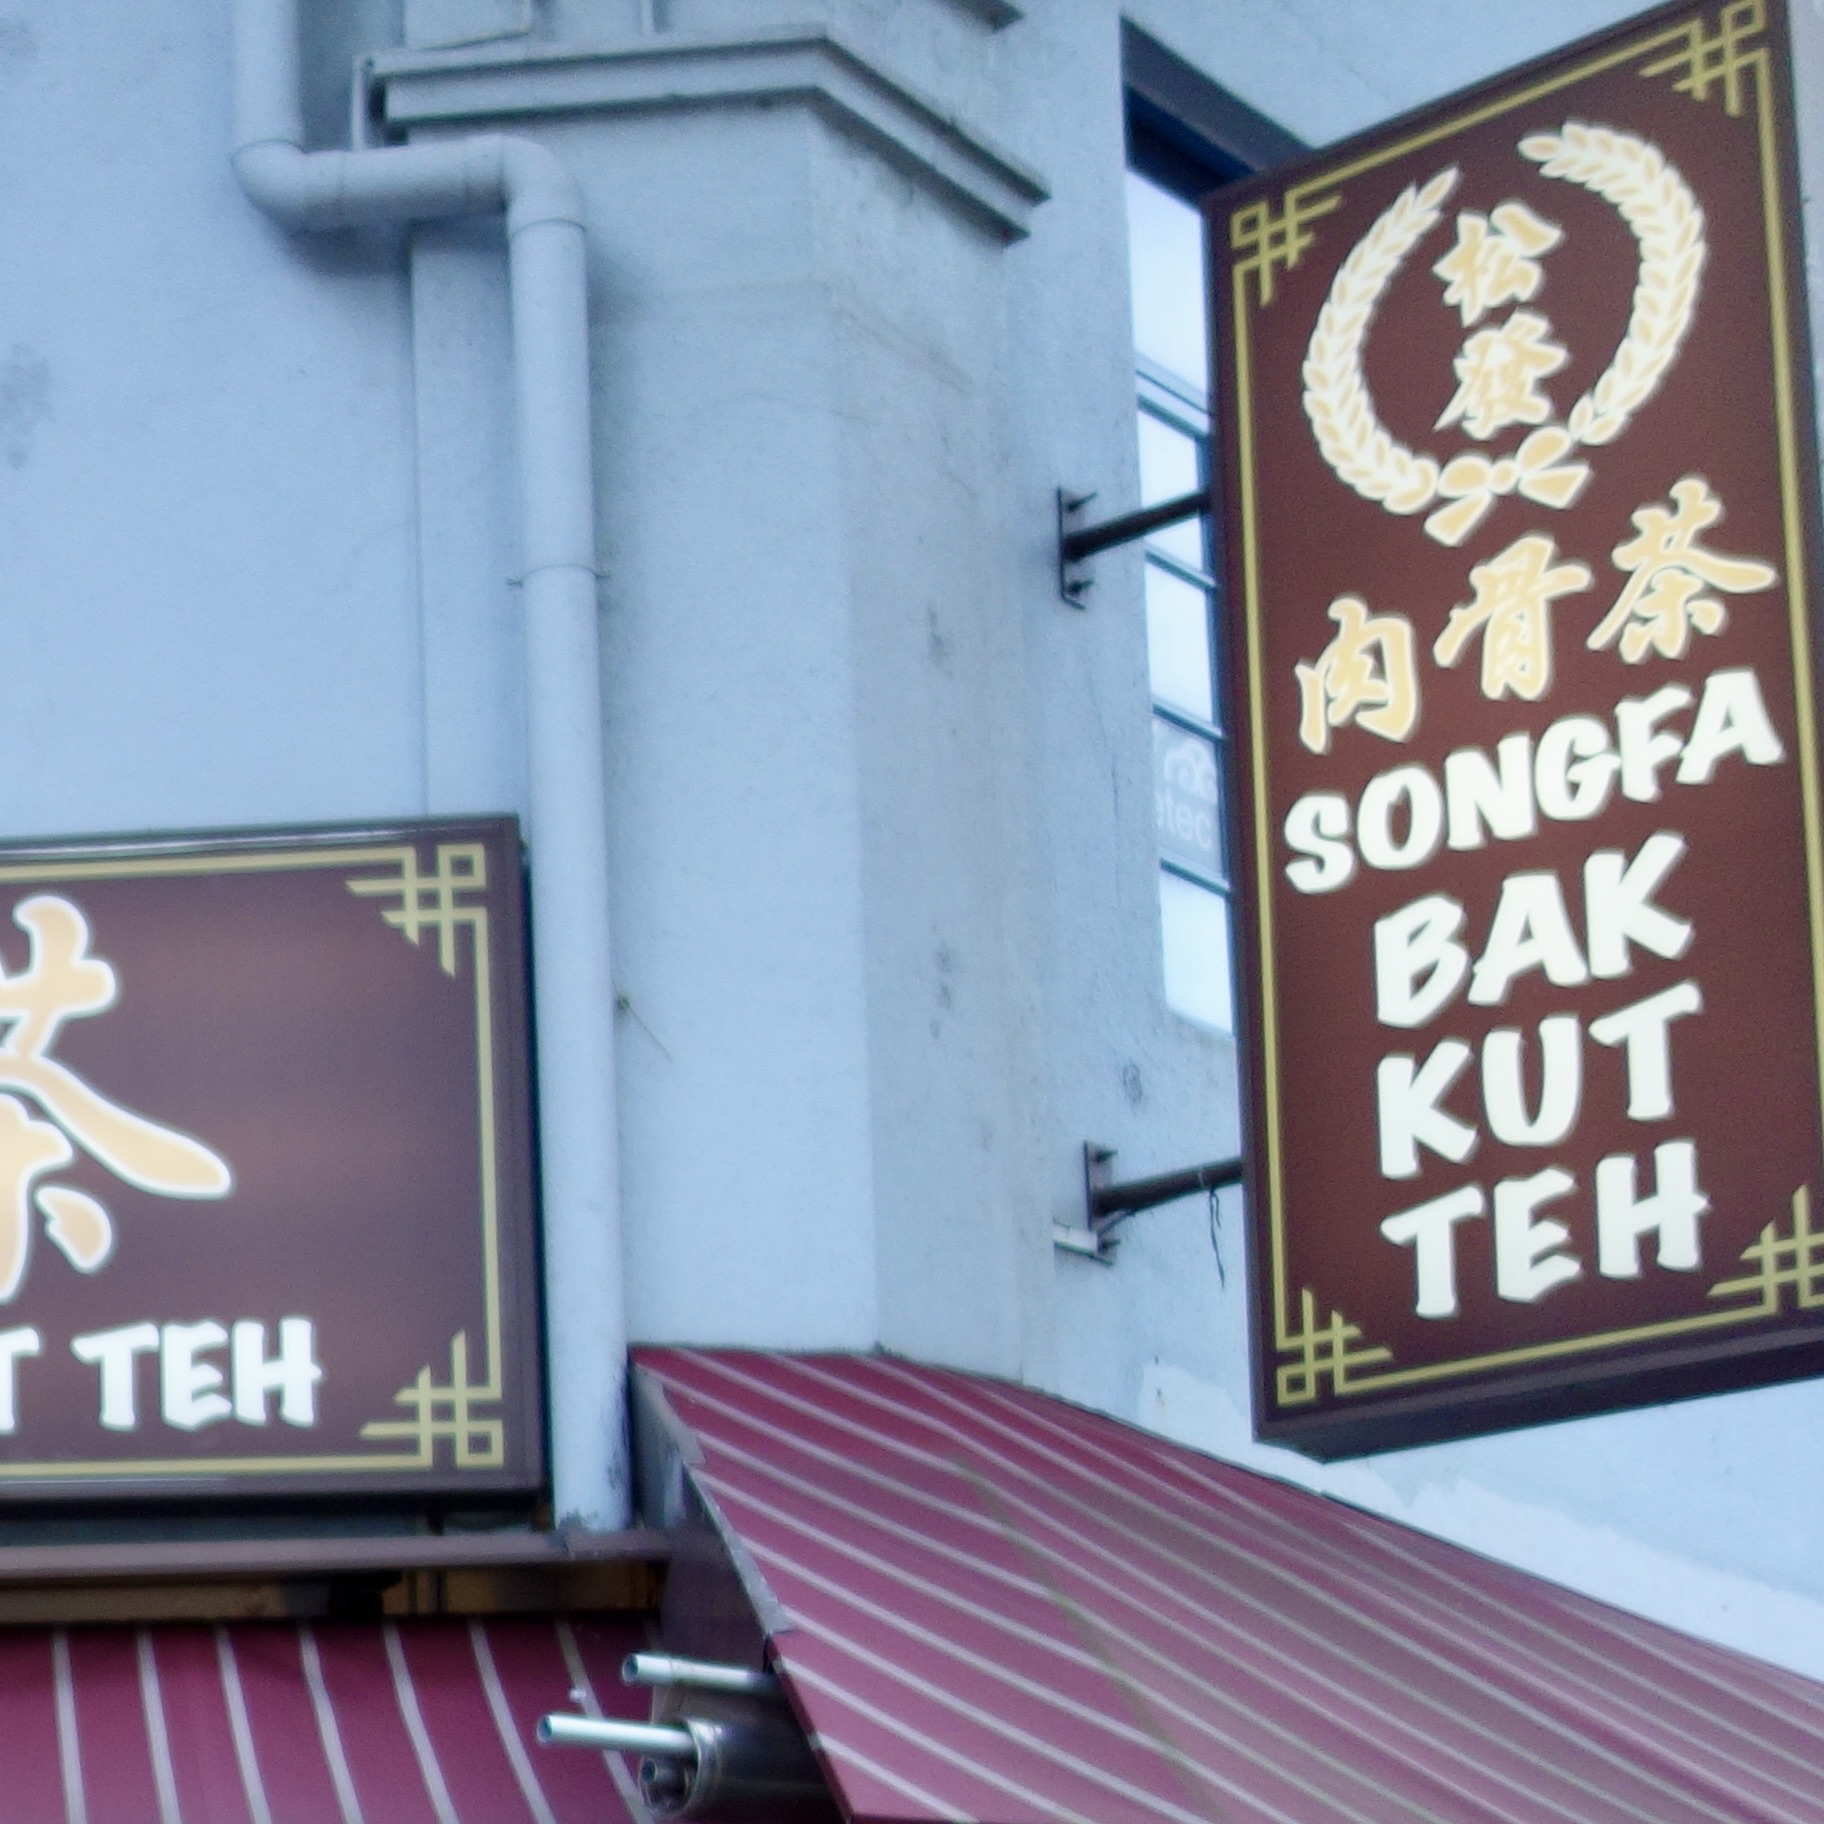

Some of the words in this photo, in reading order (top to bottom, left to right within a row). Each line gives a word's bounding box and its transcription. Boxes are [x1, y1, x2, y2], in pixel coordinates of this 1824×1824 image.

[1294, 476, 1780, 754] 肉骨茶
[1283, 669, 1785, 894] SONGFA
[1373, 831, 1693, 1029] BAK
[1376, 980, 1704, 1180] KUT
[1379, 1141, 1711, 1319] TEH
[72, 1316, 323, 1430] TEH
